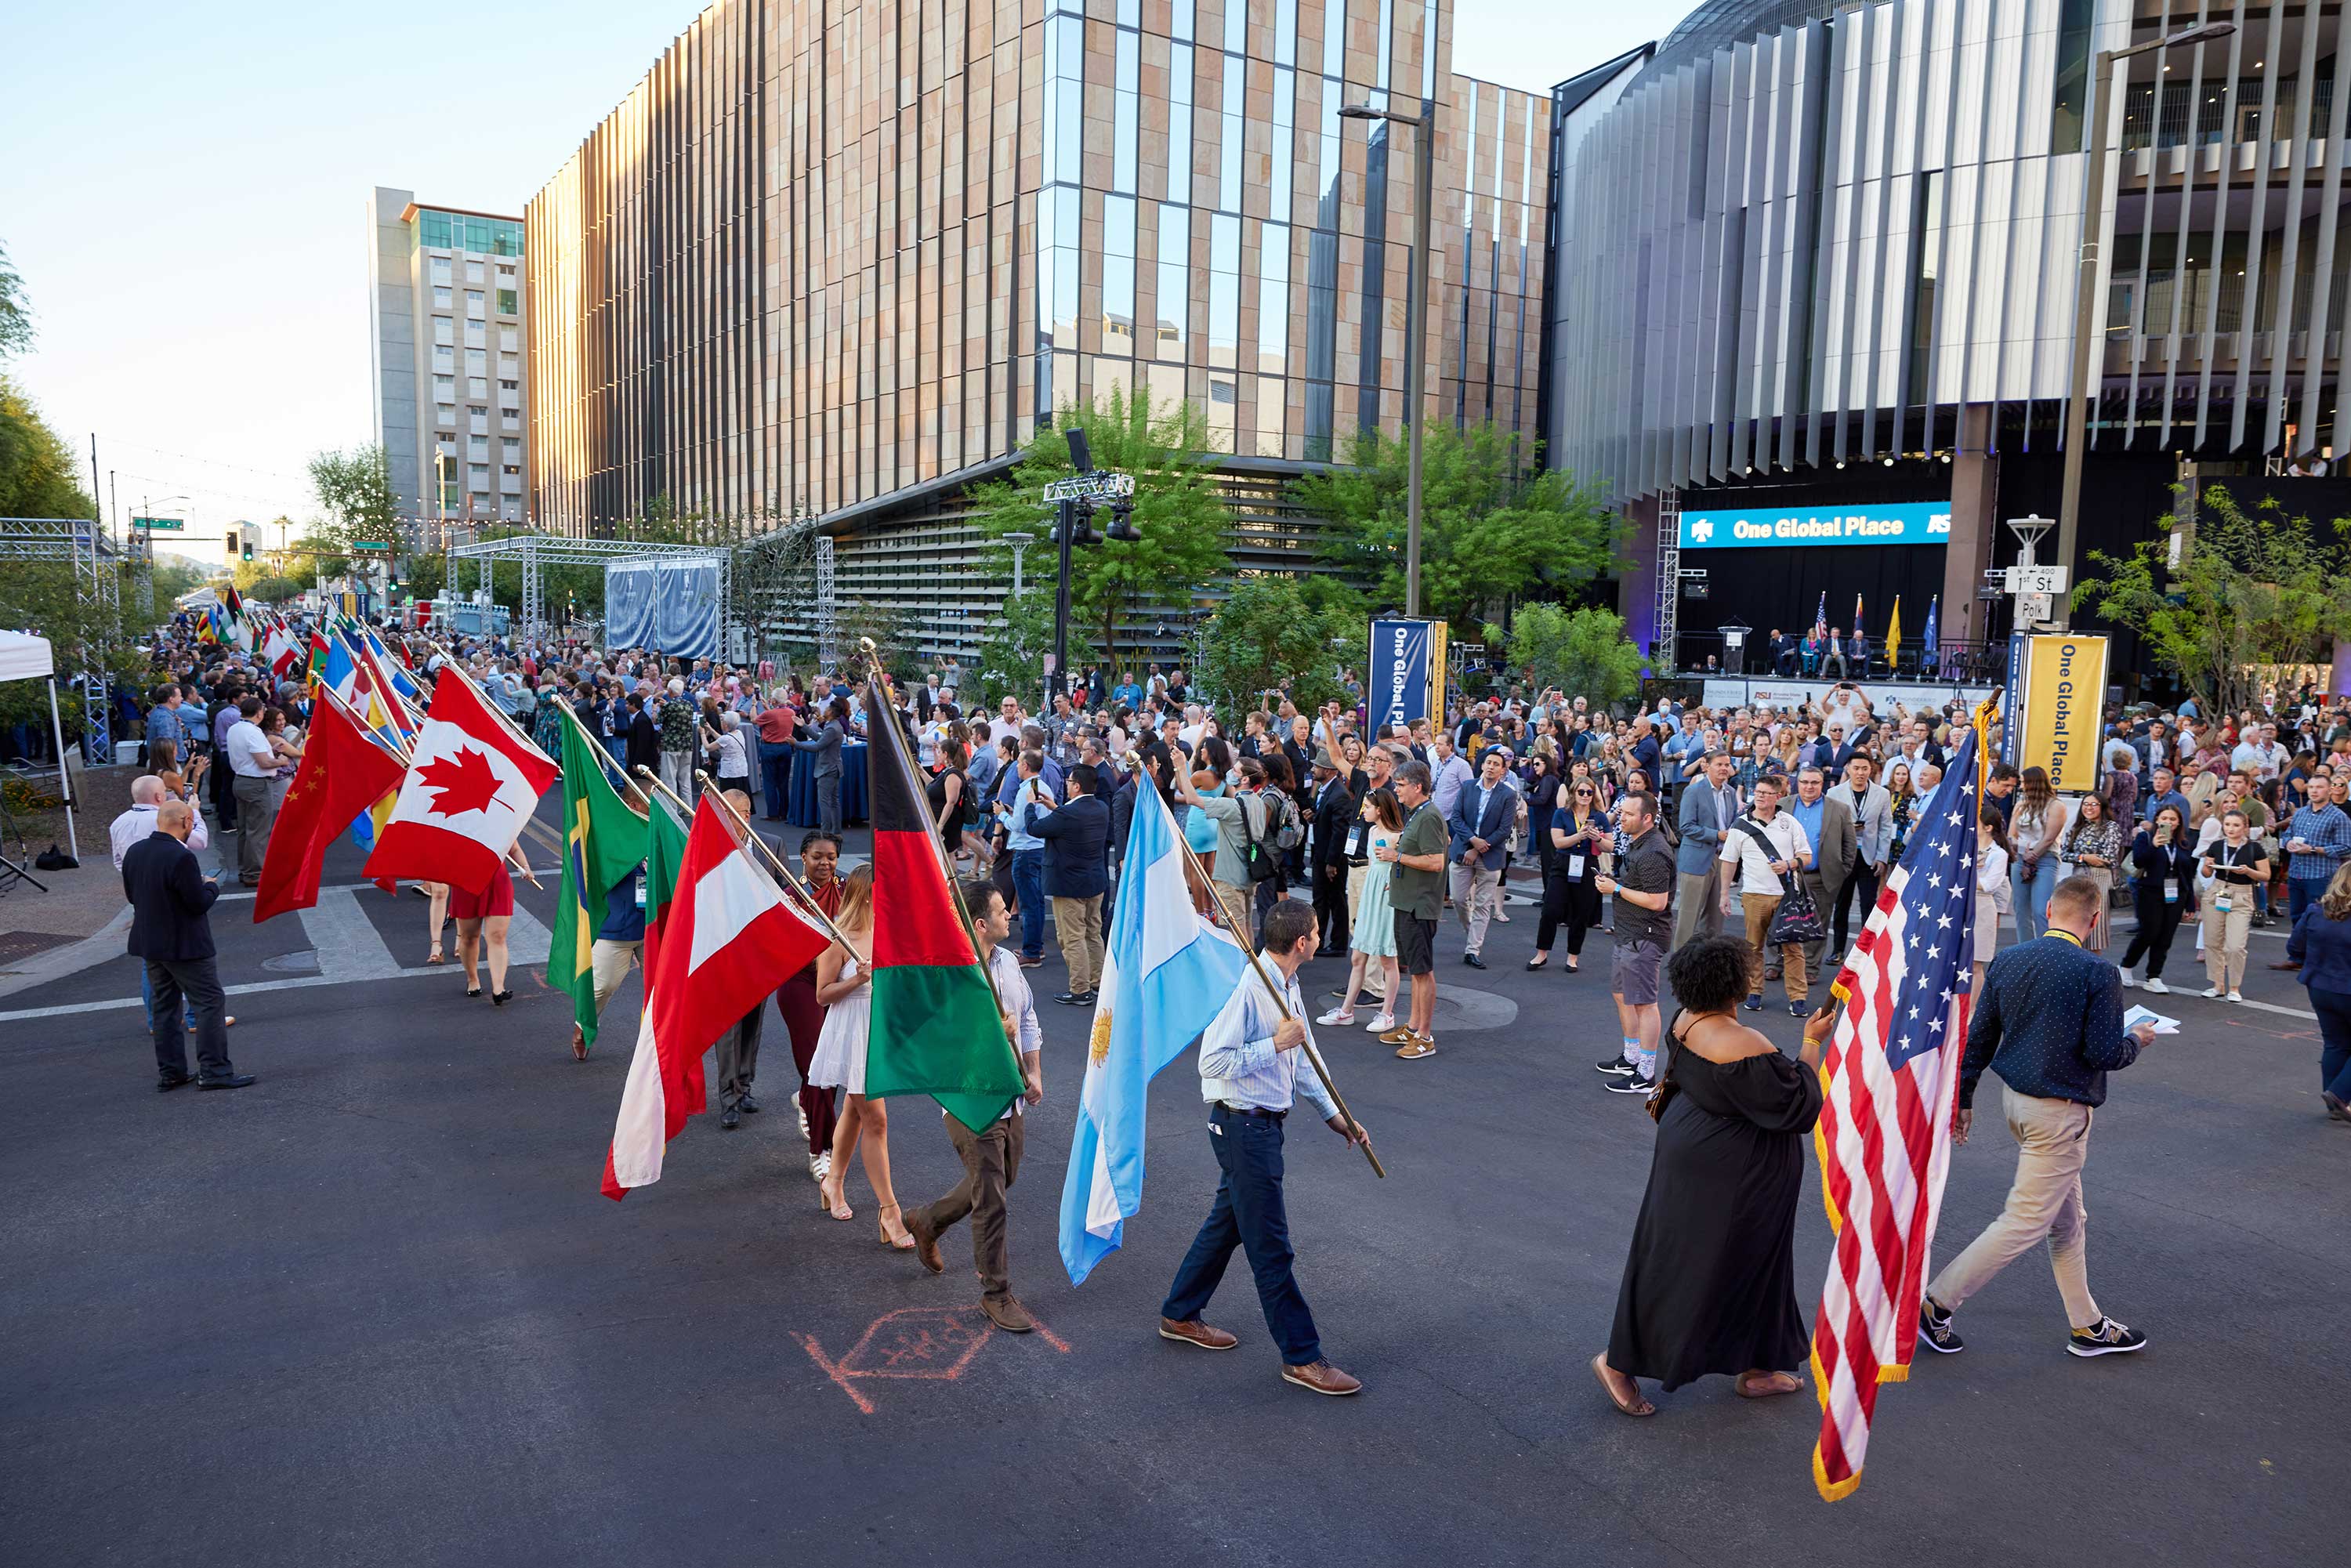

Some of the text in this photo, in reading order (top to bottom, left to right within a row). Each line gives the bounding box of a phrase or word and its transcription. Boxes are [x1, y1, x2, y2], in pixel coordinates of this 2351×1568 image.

[1733, 514, 1904, 539] One Global Place
[2019, 576, 2052, 591] 1st St
[2022, 603, 2043, 617] Polk
[1394, 627, 1408, 657] One
[1391, 659, 1407, 708] Global
[1754, 691, 1772, 700] ASU
[2050, 644, 2076, 786] One Global Place
